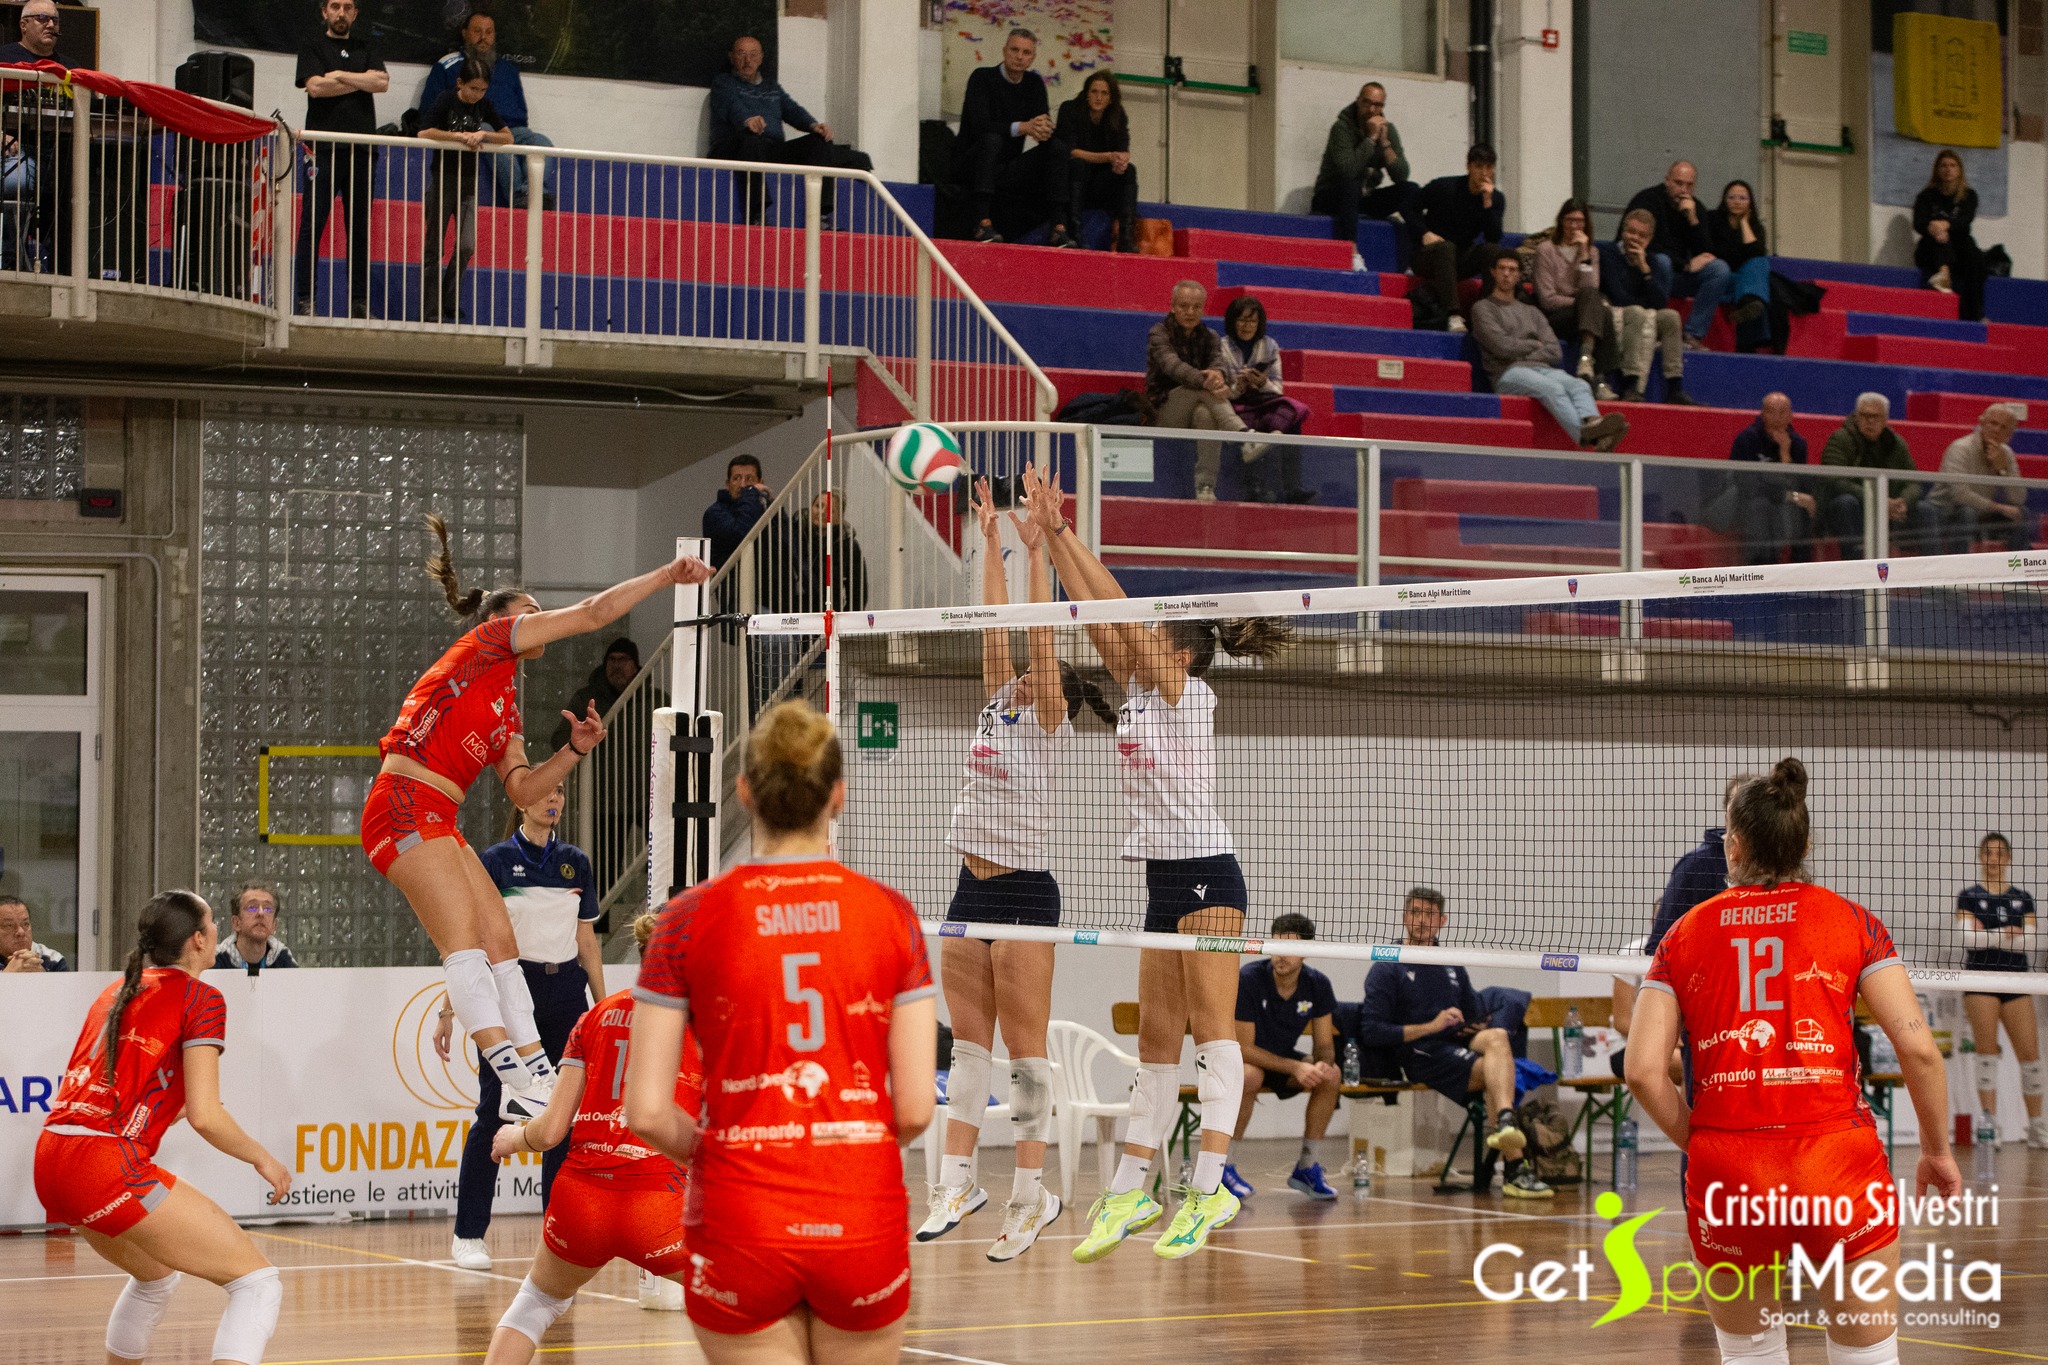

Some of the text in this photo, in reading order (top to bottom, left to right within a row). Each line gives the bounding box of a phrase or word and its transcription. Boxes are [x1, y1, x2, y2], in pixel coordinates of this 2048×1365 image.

[2023, 558, 2047, 567] Banca
[1692, 572, 1765, 585] Banca Alpi Marittime
[1409, 587, 1472, 599] Banca Alpi Marittime
[1164, 600, 1219, 611] Banca Alpi Marittime
[950, 612, 964, 620] Banca
[963, 611, 974, 620] Alpi
[755, 900, 841, 937] SANGOI
[1719, 902, 1798, 927] BERGESE
[941, 925, 965, 934] FINECO
[1544, 957, 1576, 968] FINECO
[1730, 936, 1784, 1012] 12
[781, 952, 826, 1053] 5
[1786, 1041, 1835, 1054] GUNETTO
[368, 1182, 385, 1202] le
[397, 1179, 459, 1201] attivit
[83, 1191, 132, 1225] AZZURRO
[801, 1223, 843, 1238] nine
